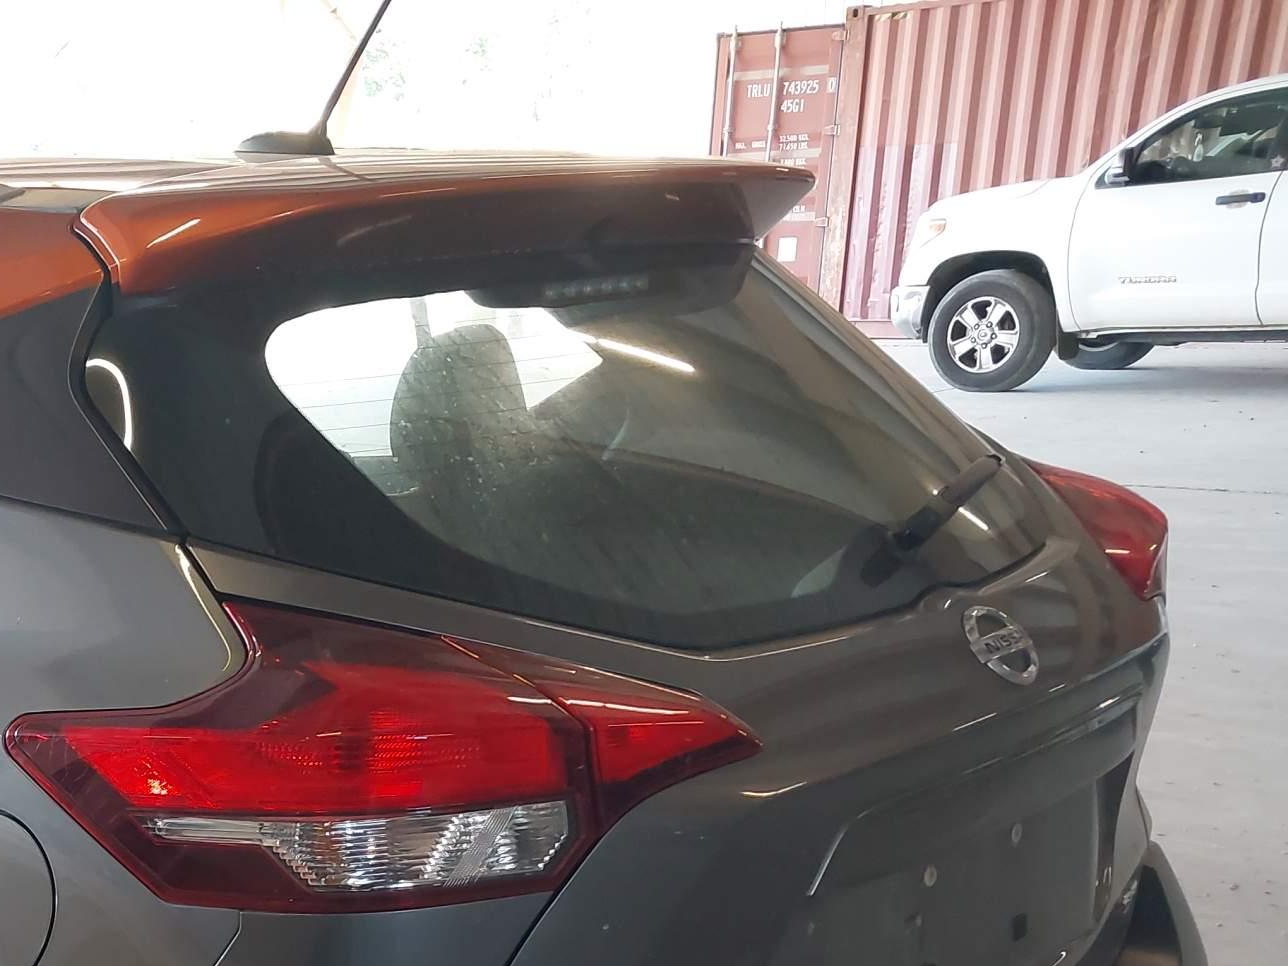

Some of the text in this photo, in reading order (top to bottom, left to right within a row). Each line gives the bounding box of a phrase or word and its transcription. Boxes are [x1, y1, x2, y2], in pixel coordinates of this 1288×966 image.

[746, 83, 771, 98] TRLU
[782, 80, 820, 96] 743925
[780, 98, 805, 113] 45G1
